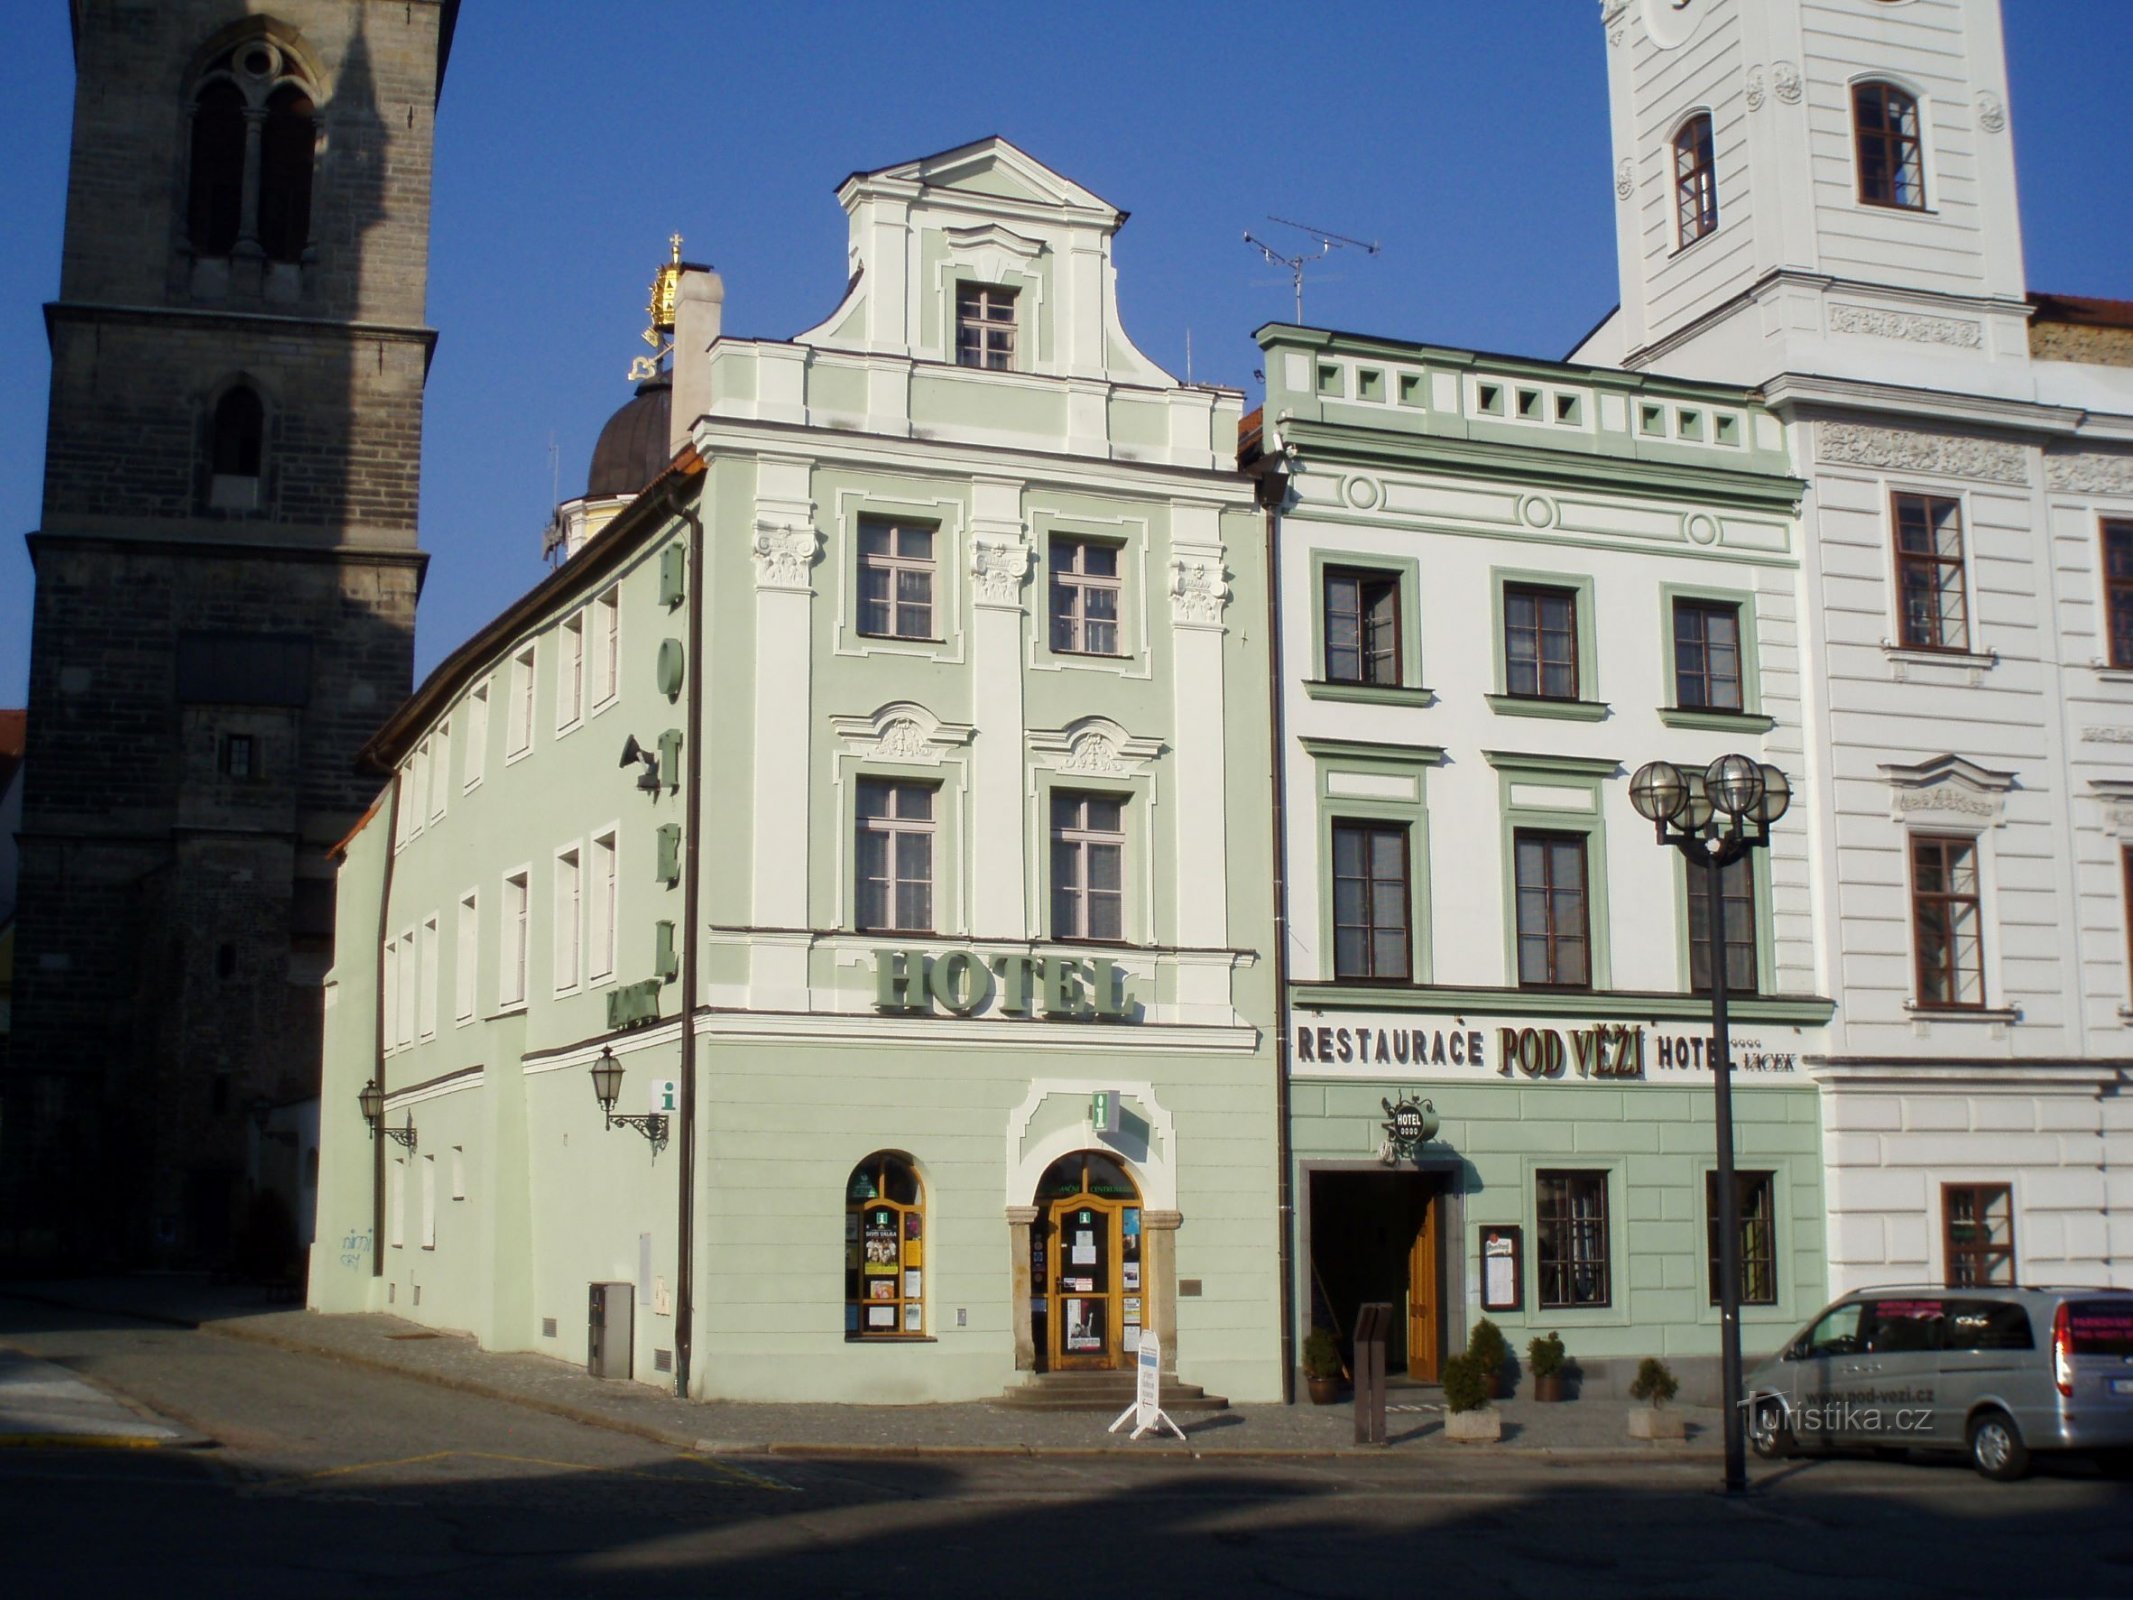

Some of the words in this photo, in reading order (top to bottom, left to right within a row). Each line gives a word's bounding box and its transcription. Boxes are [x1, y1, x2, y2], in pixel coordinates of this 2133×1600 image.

[872, 948, 1135, 1015] HOTEL
[1297, 1026, 1484, 1067] RESTAURACE
[1496, 1027, 1564, 1076] POD
[1397, 1113, 1421, 1126] HOTEL
